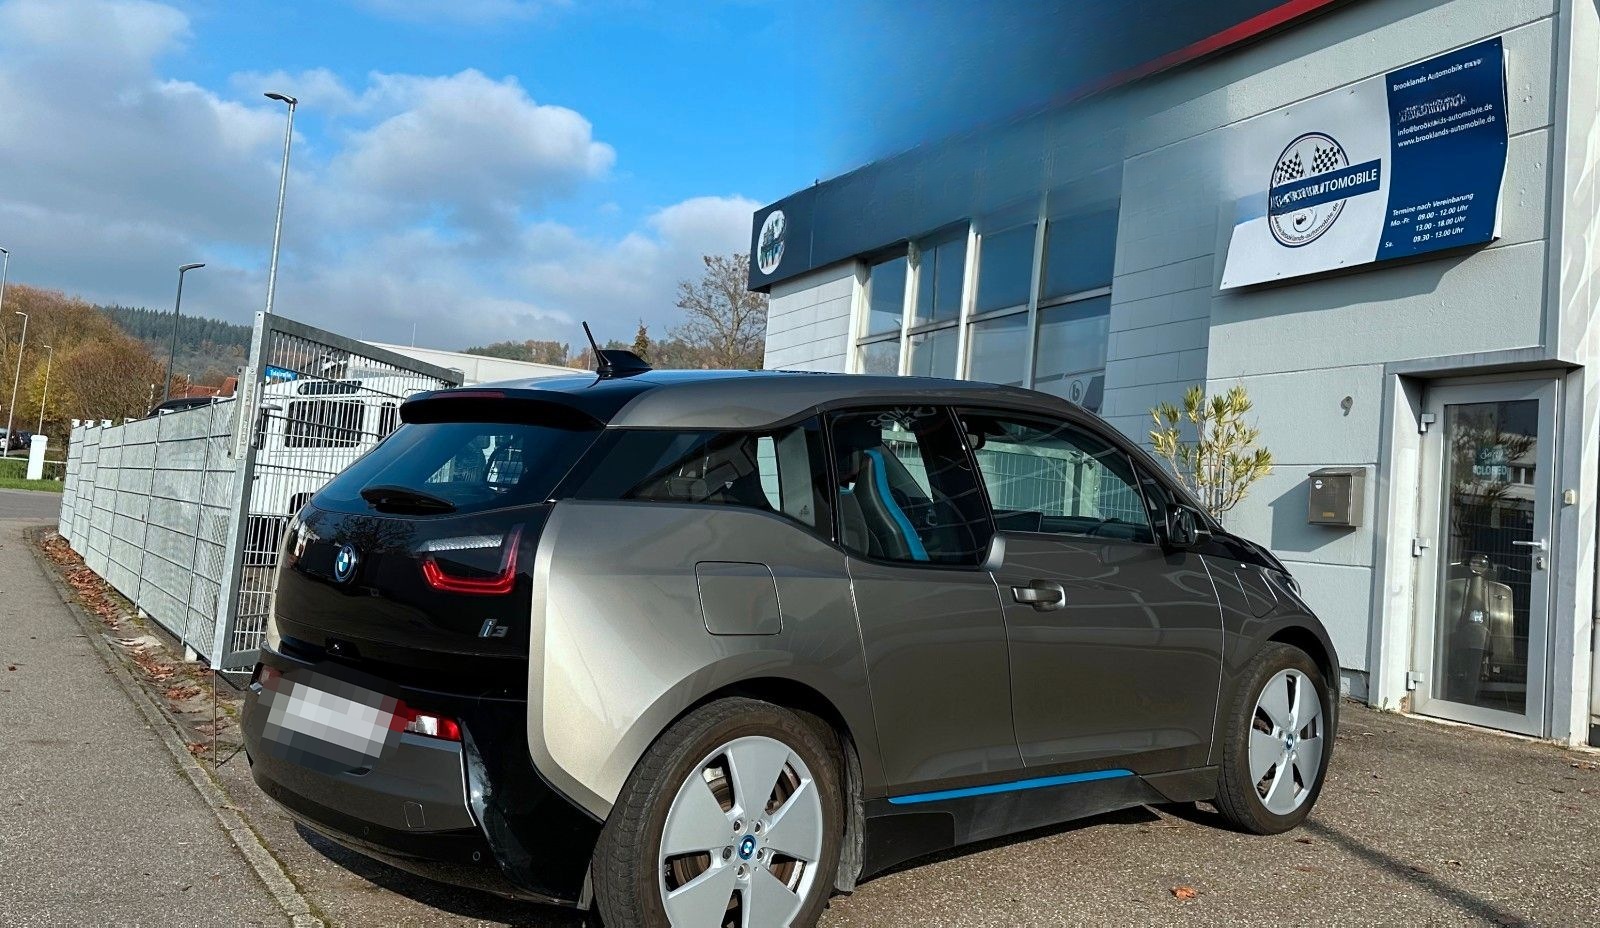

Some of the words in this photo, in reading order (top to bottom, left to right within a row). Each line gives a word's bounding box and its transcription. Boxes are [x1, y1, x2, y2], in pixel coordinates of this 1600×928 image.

[1393, 76, 1427, 92] Brooklands
[1427, 63, 1463, 81] Automobile
[1397, 115, 1496, 147] www.brooklands-automobile.de
[1392, 206, 1416, 217] Termine
[1416, 202, 1431, 211] nach
[1432, 193, 1474, 208] Vereinbarung
[1417, 211, 1434, 221] 09.00
[1440, 206, 1456, 217] 12.00
[1457, 203, 1470, 213] Uhr
[1415, 222, 1432, 232] 13.00
[1437, 217, 1454, 228] 18.00
[1454, 215, 1467, 224] Uhr
[1435, 229, 1451, 239] 13.00
[1452, 226, 1464, 235] Uhr
[1341, 395, 1354, 417] 9
[477, 618, 509, 638] i3
